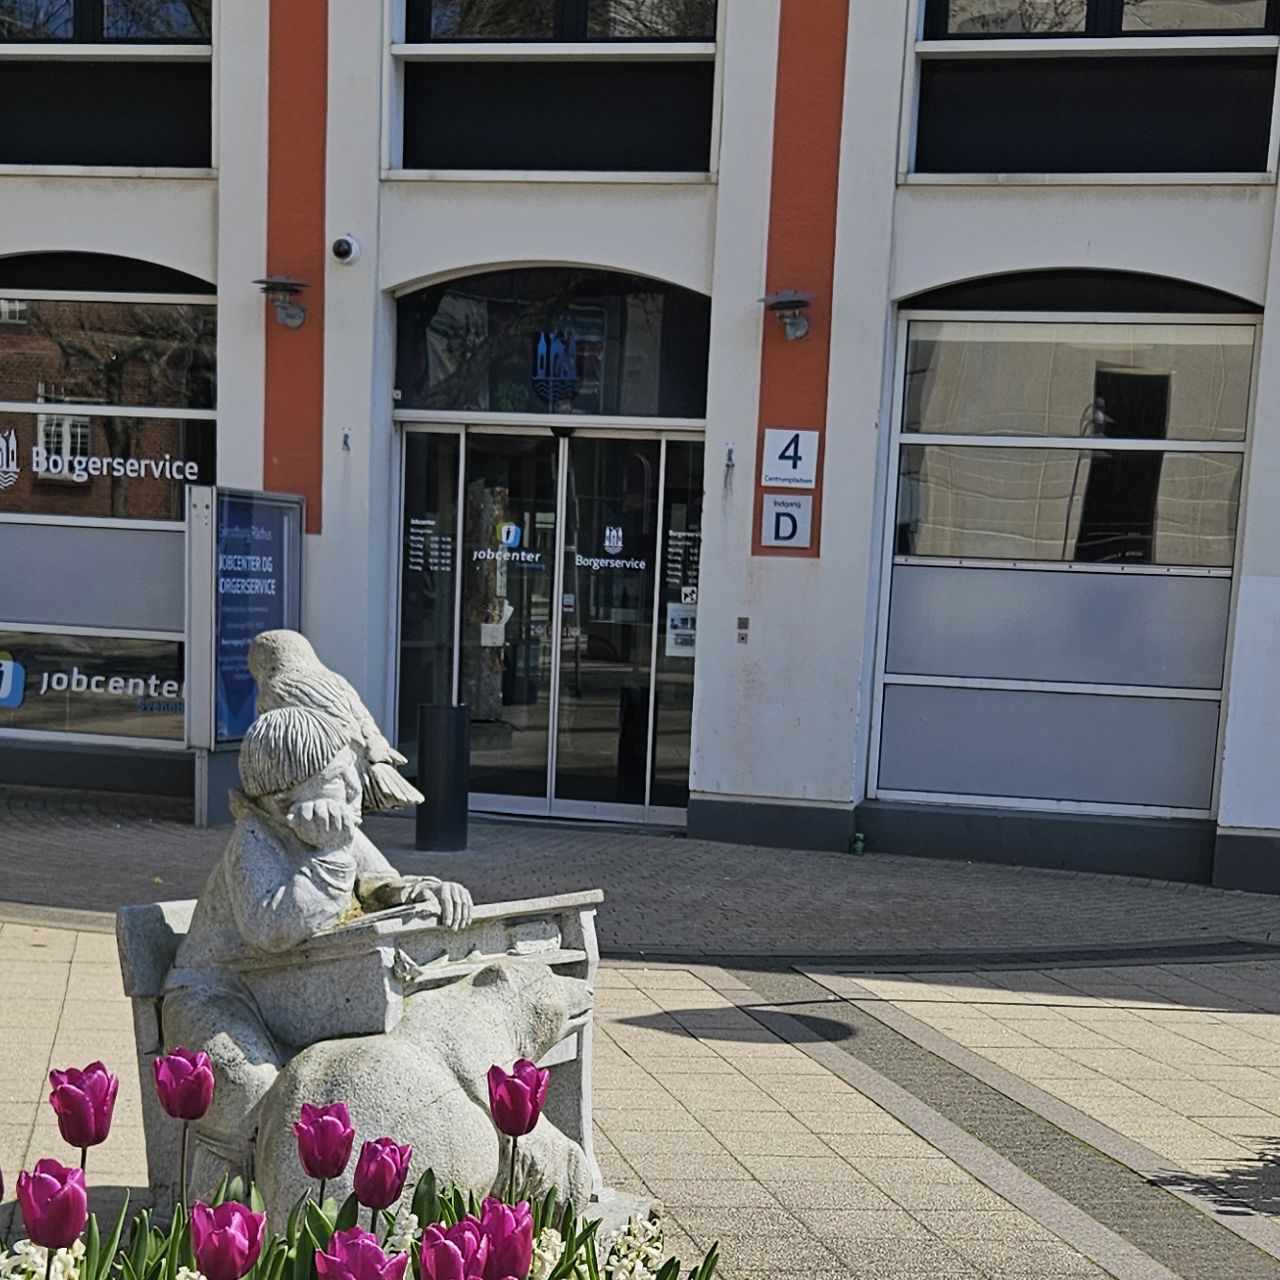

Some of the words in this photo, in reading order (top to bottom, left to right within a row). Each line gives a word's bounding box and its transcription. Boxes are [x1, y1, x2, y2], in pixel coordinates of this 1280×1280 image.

[778, 433, 802, 470] 4
[31, 445, 199, 483] Borgerservice
[773, 500, 802, 509] Indgang
[773, 512, 798, 541] D
[219, 554, 261, 572] JOBCENTER
[262, 557, 273, 572] OG
[472, 548, 541, 562] jobcenter
[575, 554, 646, 570] Borgerservice
[219, 577, 276, 595] ORGERSERVICE
